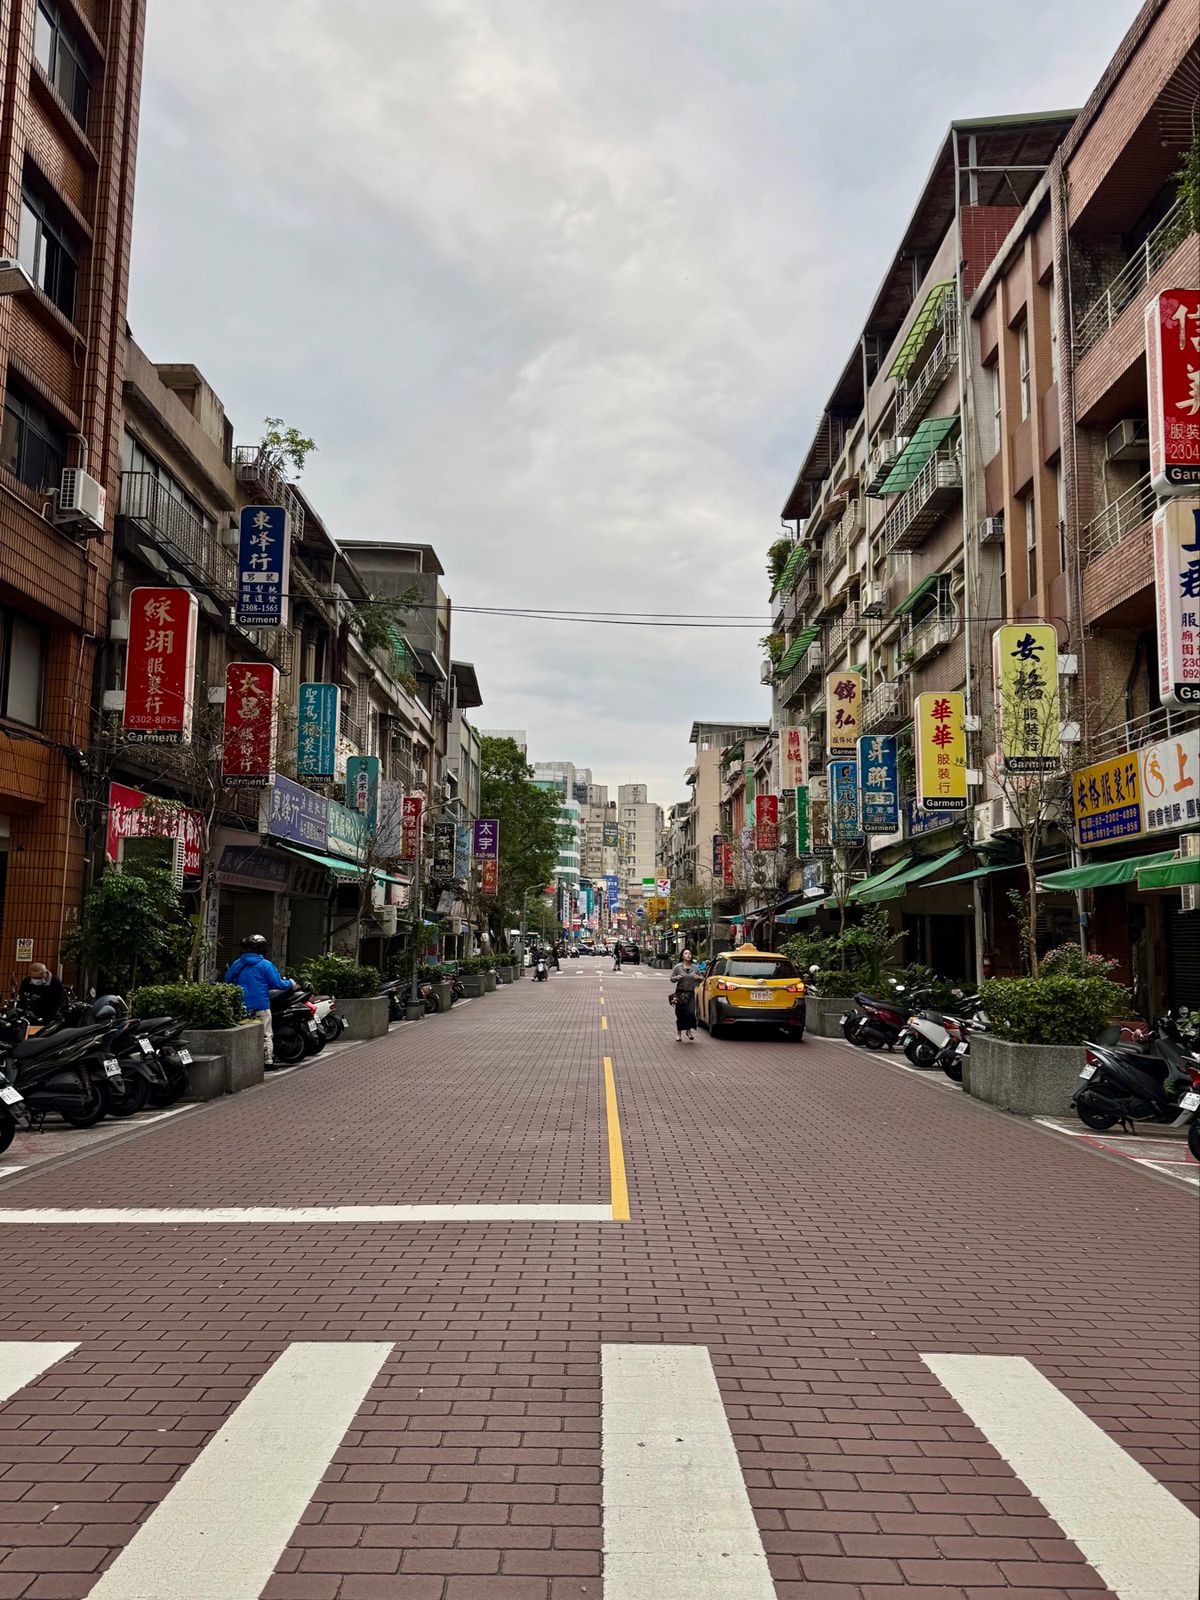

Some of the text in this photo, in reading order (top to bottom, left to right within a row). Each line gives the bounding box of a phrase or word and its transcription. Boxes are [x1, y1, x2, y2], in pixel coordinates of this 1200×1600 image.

[1171, 468, 1200, 480] Gar
[248, 510, 276, 571] 東峰行
[240, 604, 278, 612] 2308-1565
[239, 615, 278, 624] Garment
[127, 732, 178, 743] Garment
[831, 748, 857, 756] Garmen
[1009, 758, 1057, 769] Garment
[225, 777, 267, 786] Garment
[926, 799, 964, 808] Garment
[478, 822, 493, 850] 太宇
